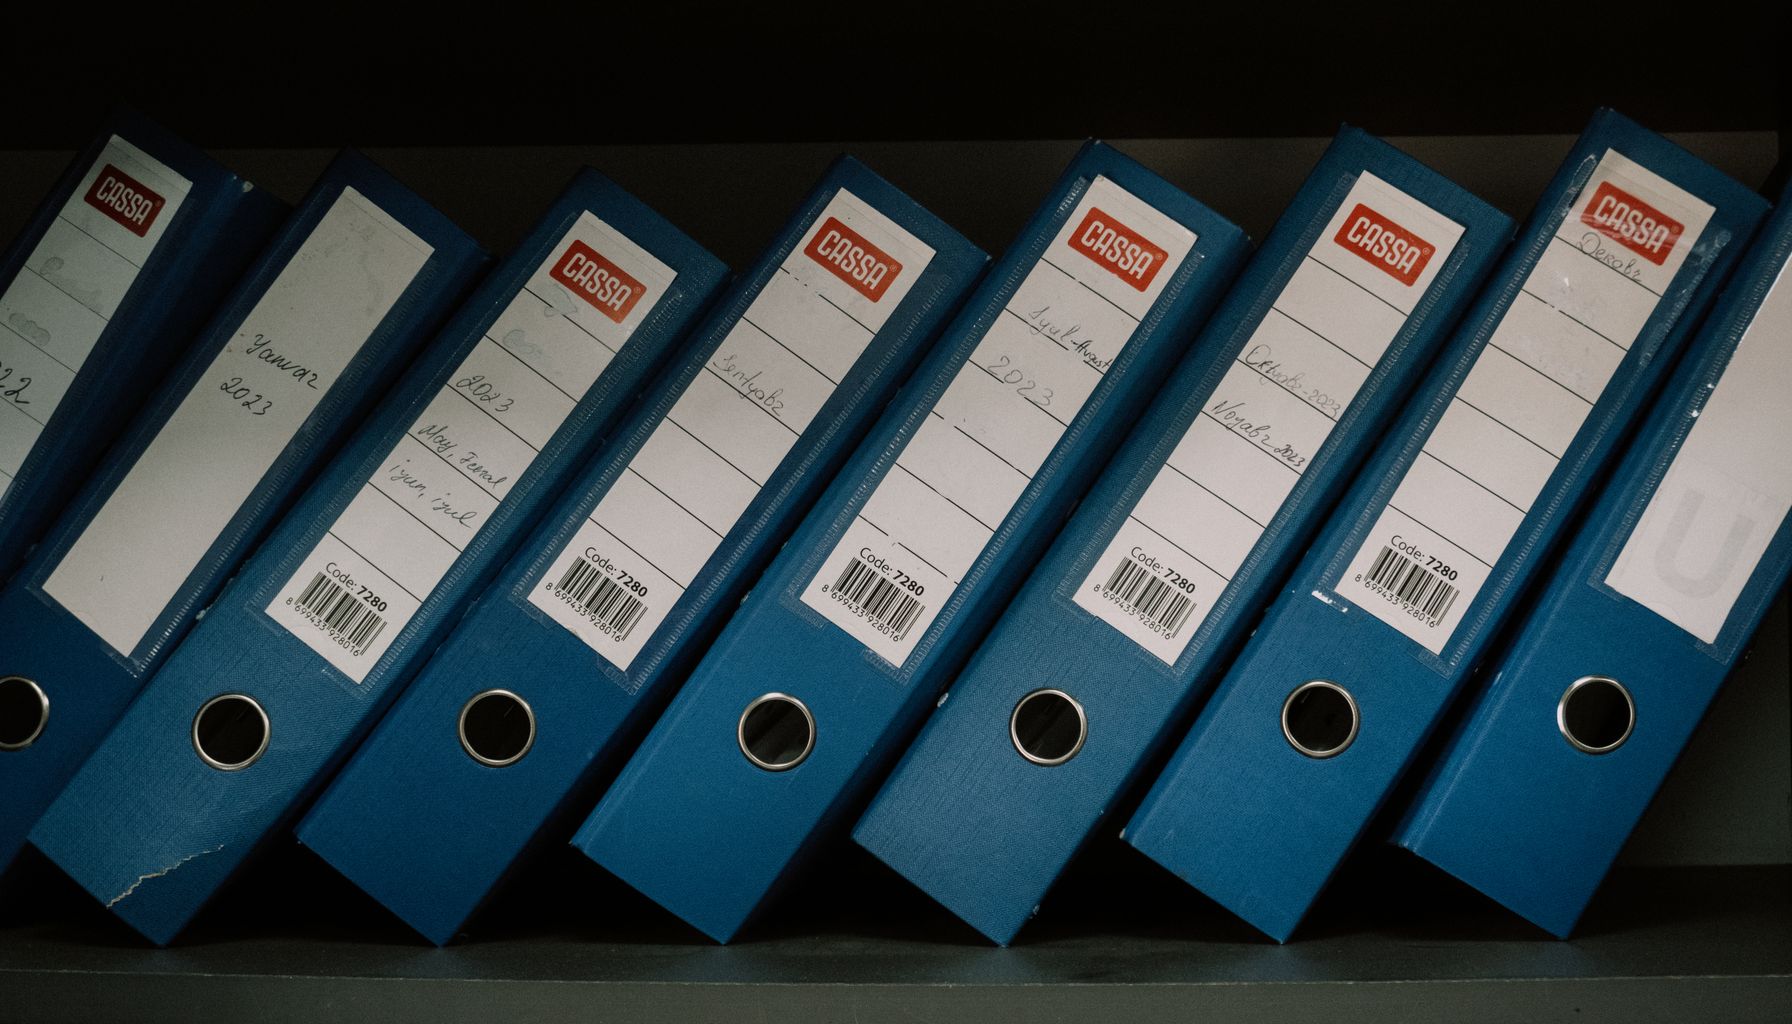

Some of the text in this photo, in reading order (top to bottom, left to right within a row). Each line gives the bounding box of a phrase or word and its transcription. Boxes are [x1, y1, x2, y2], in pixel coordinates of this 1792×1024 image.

[96, 176, 153, 226] CASSA
[1593, 194, 1671, 254] CASSA
[816, 229, 888, 291] CASSA
[1080, 220, 1154, 280] CASSA
[1346, 216, 1421, 275] CASSA
[562, 252, 633, 312] CASSA
[220, 377, 273, 416] 2023
[455, 374, 515, 413] 2023
[987, 355, 1054, 407] 2023
[585, 546, 648, 597] Code: 7280
[860, 547, 925, 596] Code: 7280
[1131, 546, 1196, 594] Code: 7280
[1391, 535, 1458, 582] Code: 7280
[325, 562, 388, 612] Code: 7280
[545, 582, 621, 642] 8 699433 928016
[821, 584, 900, 642] 8 699433 928016
[1093, 583, 1171, 640] 8 699433 928016
[1354, 573, 1436, 628] 8 699433 928016
[285, 597, 361, 657] 8 699433 928016
